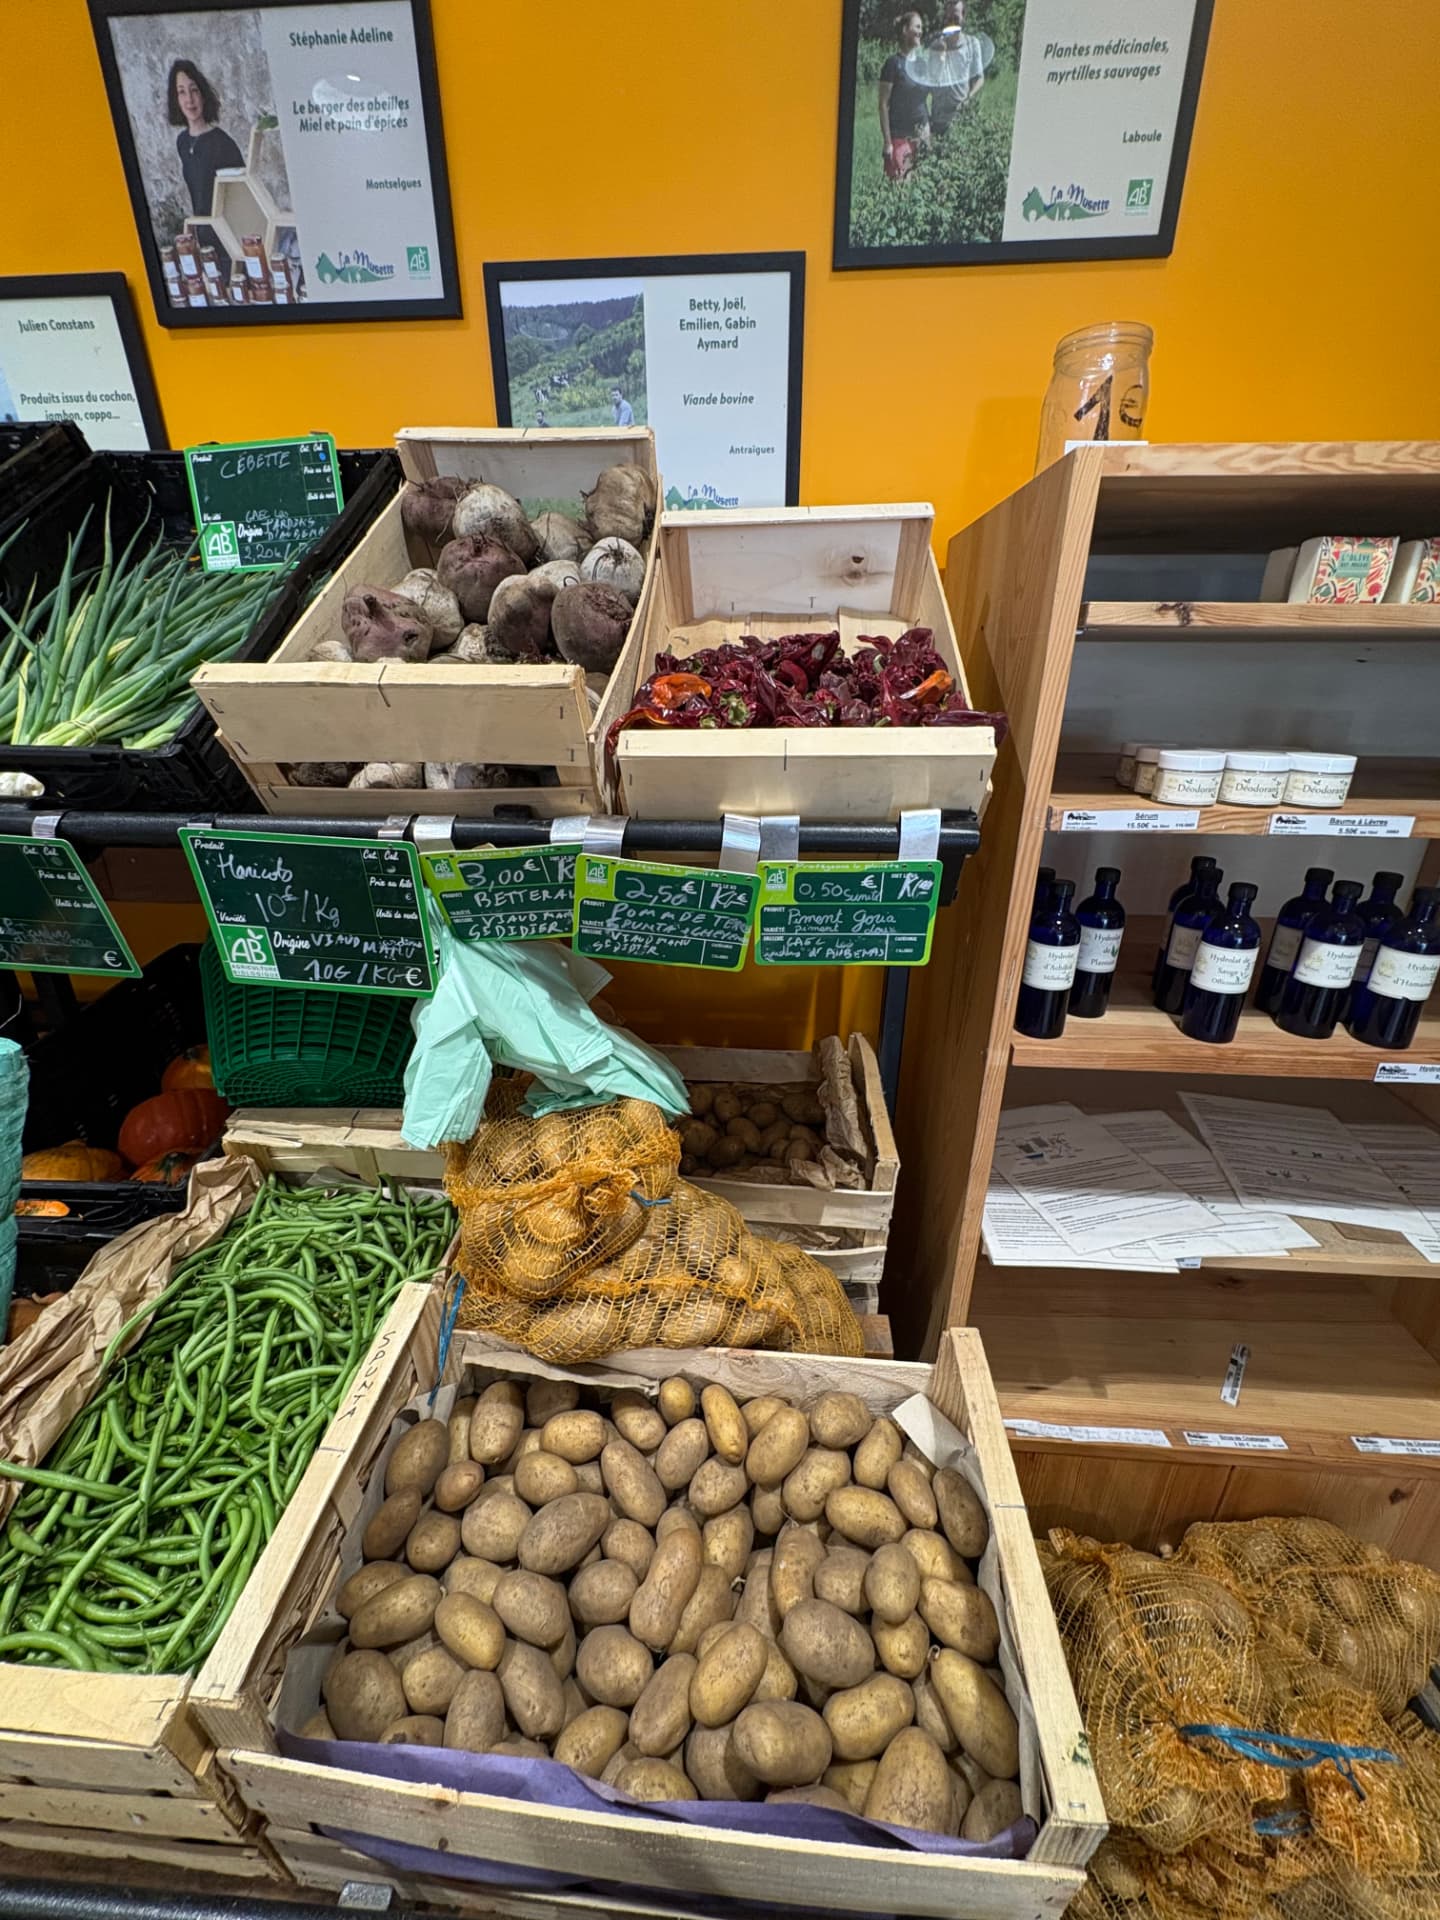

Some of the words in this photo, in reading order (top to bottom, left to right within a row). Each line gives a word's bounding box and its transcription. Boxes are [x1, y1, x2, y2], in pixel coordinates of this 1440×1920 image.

[289, 29, 347, 48] Stéphanie
[350, 28, 393, 43] Adeline
[1044, 43, 1091, 59] Plantes
[1093, 37, 1169, 56] médicinales,
[1047, 64, 1101, 85] myrtilles
[1103, 65, 1161, 80] sauvages
[293, 101, 305, 114] Le
[308, 100, 344, 114] berger
[347, 98, 365, 111] des
[367, 96, 409, 110] abeilles
[300, 118, 322, 132] Miel
[325, 118, 335, 130] et
[338, 119, 361, 133] pain
[365, 115, 408, 132] d'épices
[1122, 129, 1162, 143] Laboule
[366, 177, 422, 191] Montselgues
[689, 299, 721, 312] Betty,
[723, 296, 746, 312] Joël,
[18, 320, 48, 333] Julien
[49, 320, 95, 330] Constans
[679, 318, 722, 331] Emilien,
[725, 317, 756, 329] Gabin
[697, 336, 739, 351] Aymard
[21, 393, 61, 405] Produits
[62, 392, 84, 403] issus
[86, 391, 98, 402] du
[100, 390, 136, 402] cochon,
[683, 393, 718, 406] Viande
[720, 392, 754, 404] bovine
[208, 533, 233, 554] AB
[194, 839, 224, 850] Produit
[524, 859, 541, 871] €
[589, 863, 607, 878] AB
[768, 870, 784, 884] AB
[860, 875, 878, 889] €
[681, 881, 697, 895] €
[231, 936, 266, 963] AB
[273, 931, 310, 954] Origine
[104, 951, 122, 967] €
[405, 968, 423, 986] €
[338, 1331, 396, 1422] SPUNTA
